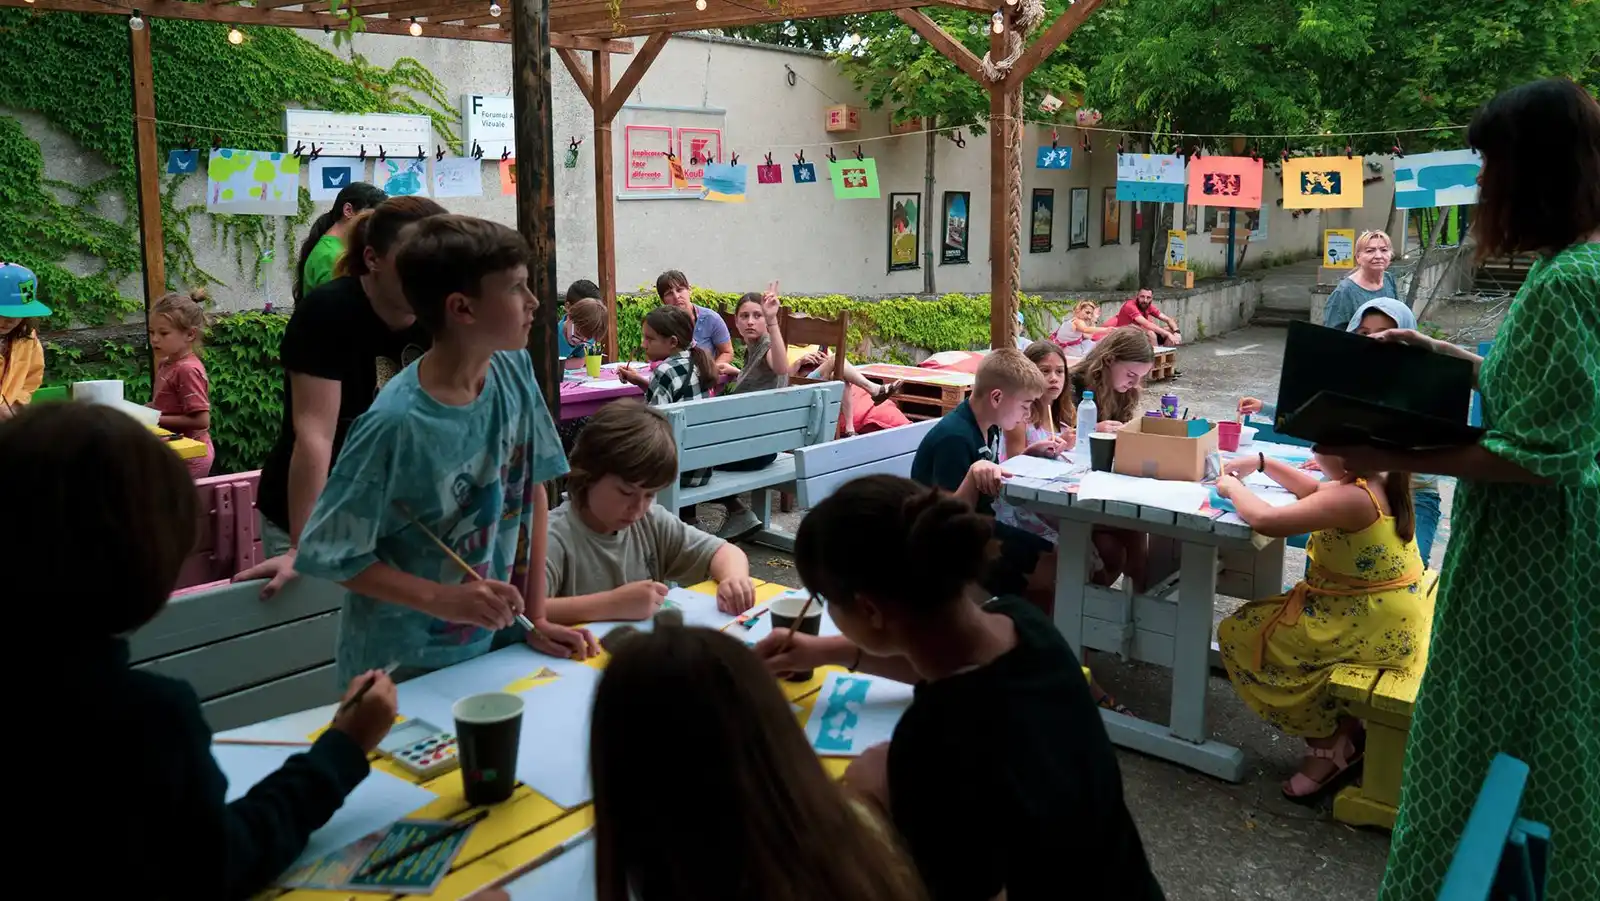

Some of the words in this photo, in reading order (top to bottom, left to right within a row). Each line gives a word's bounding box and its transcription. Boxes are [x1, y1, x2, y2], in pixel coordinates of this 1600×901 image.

[473, 96, 483, 114] F
[481, 120, 506, 128] Vizuale
[684, 168, 704, 178] Kaufl
